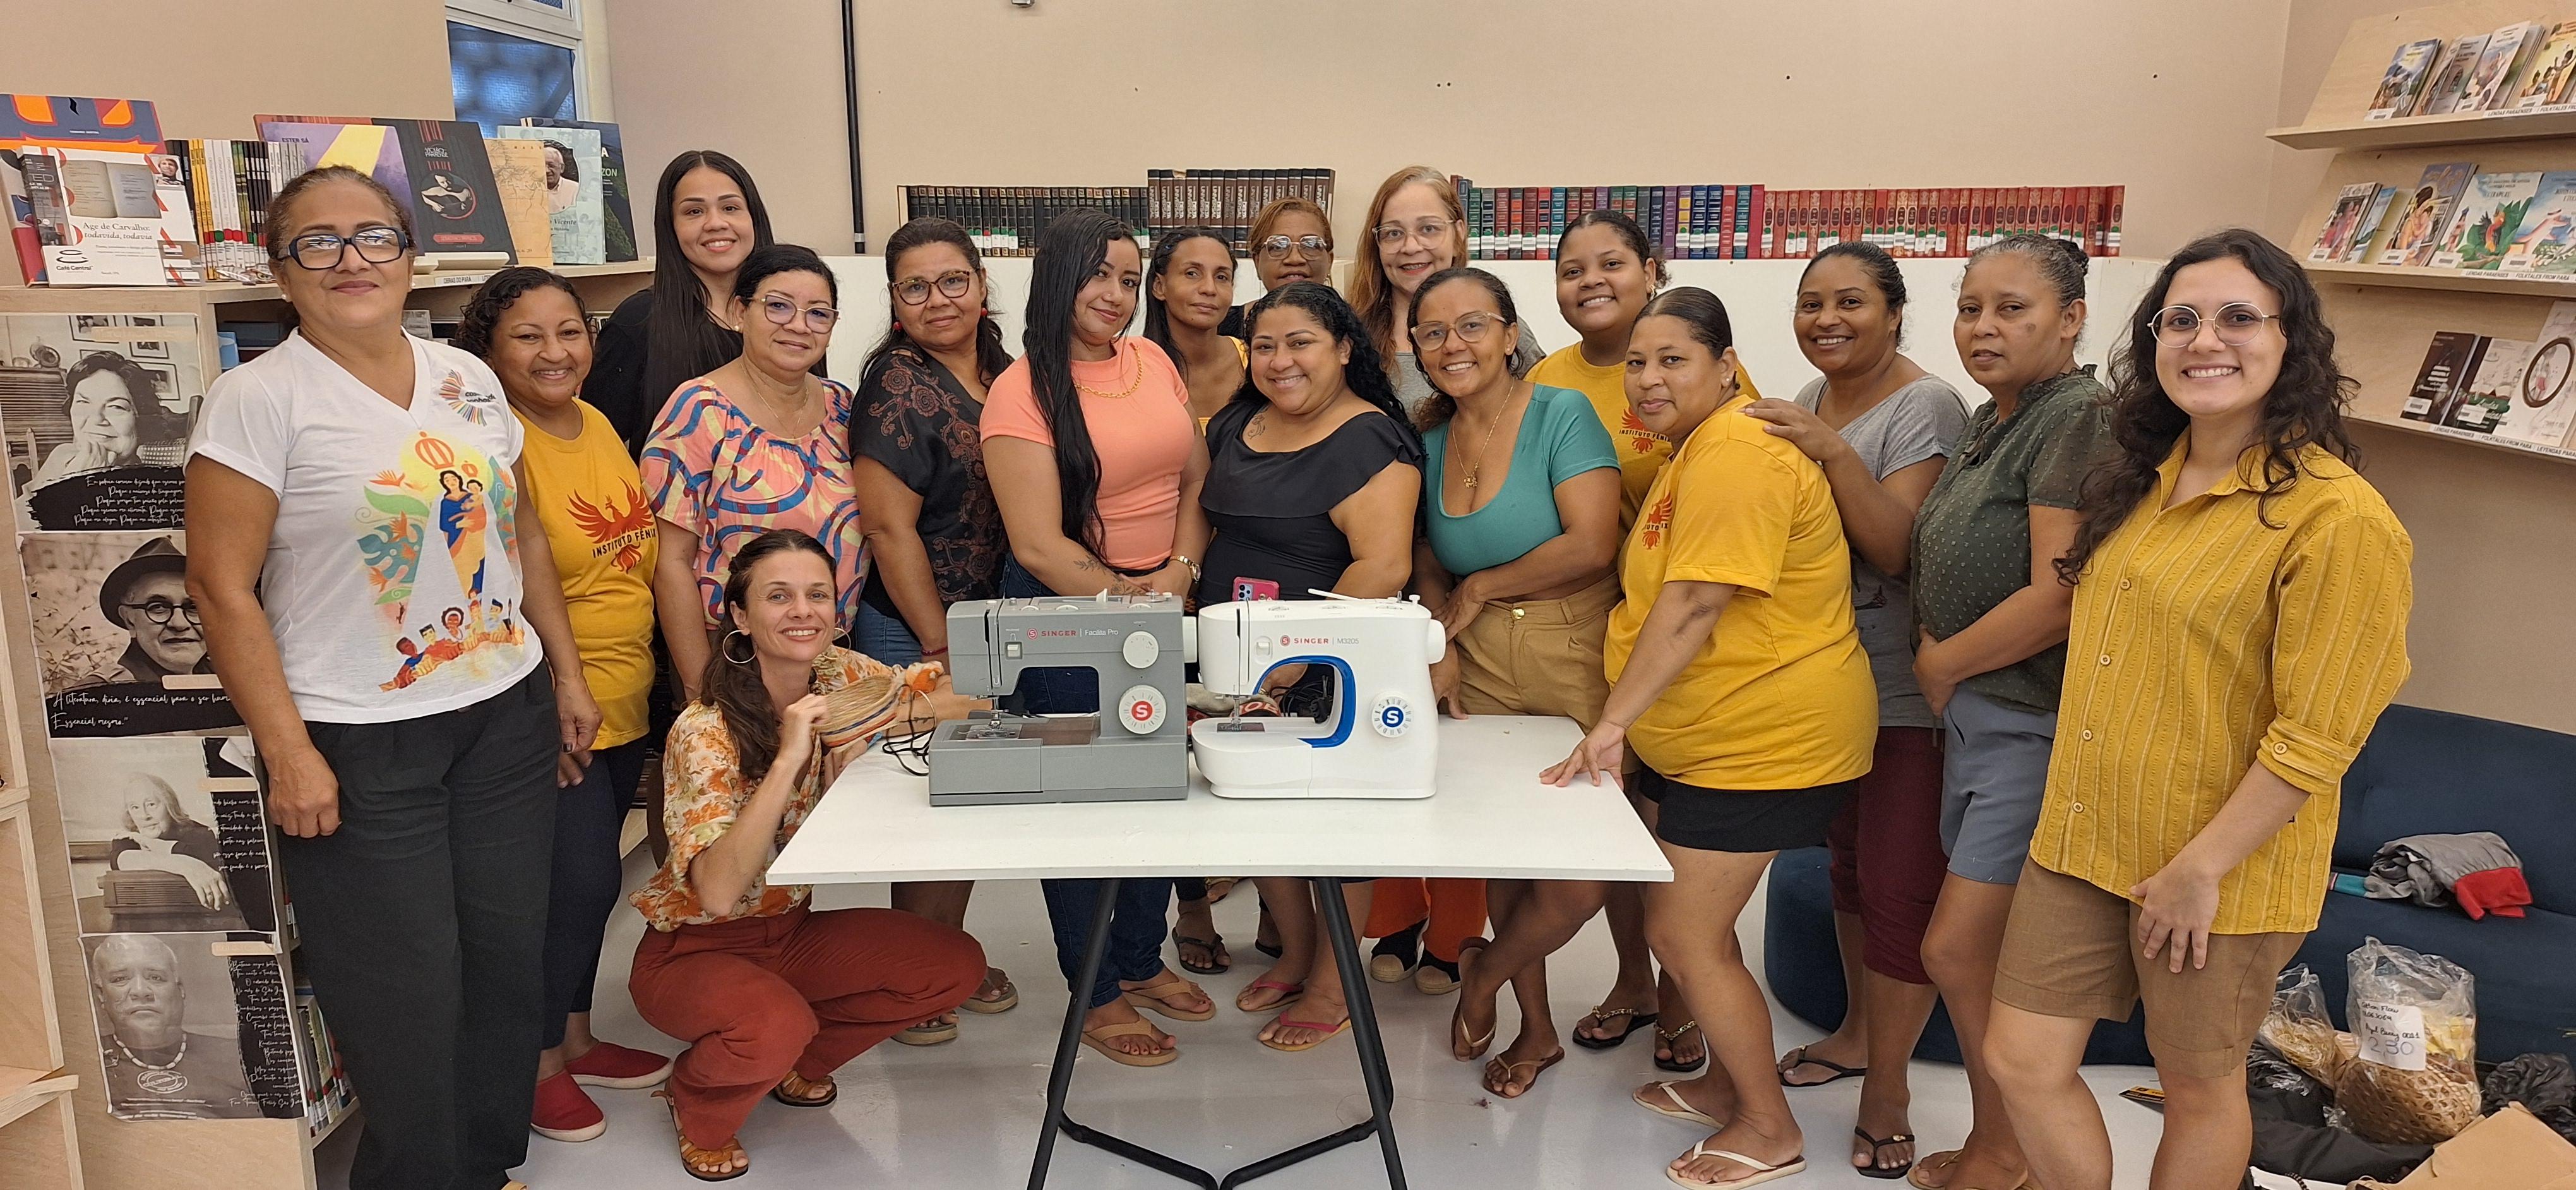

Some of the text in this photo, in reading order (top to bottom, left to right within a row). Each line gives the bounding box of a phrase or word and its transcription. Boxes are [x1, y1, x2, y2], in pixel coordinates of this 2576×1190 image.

[83, 222, 99, 231] Age
[112, 222, 150, 231] Carvalho:
[84, 232, 122, 240] todavida,
[1619, 430, 1650, 438] INSTITUTO
[592, 534, 632, 558] INSTITUTO
[1135, 704, 1148, 718] S
[1386, 712, 1399, 724] S
